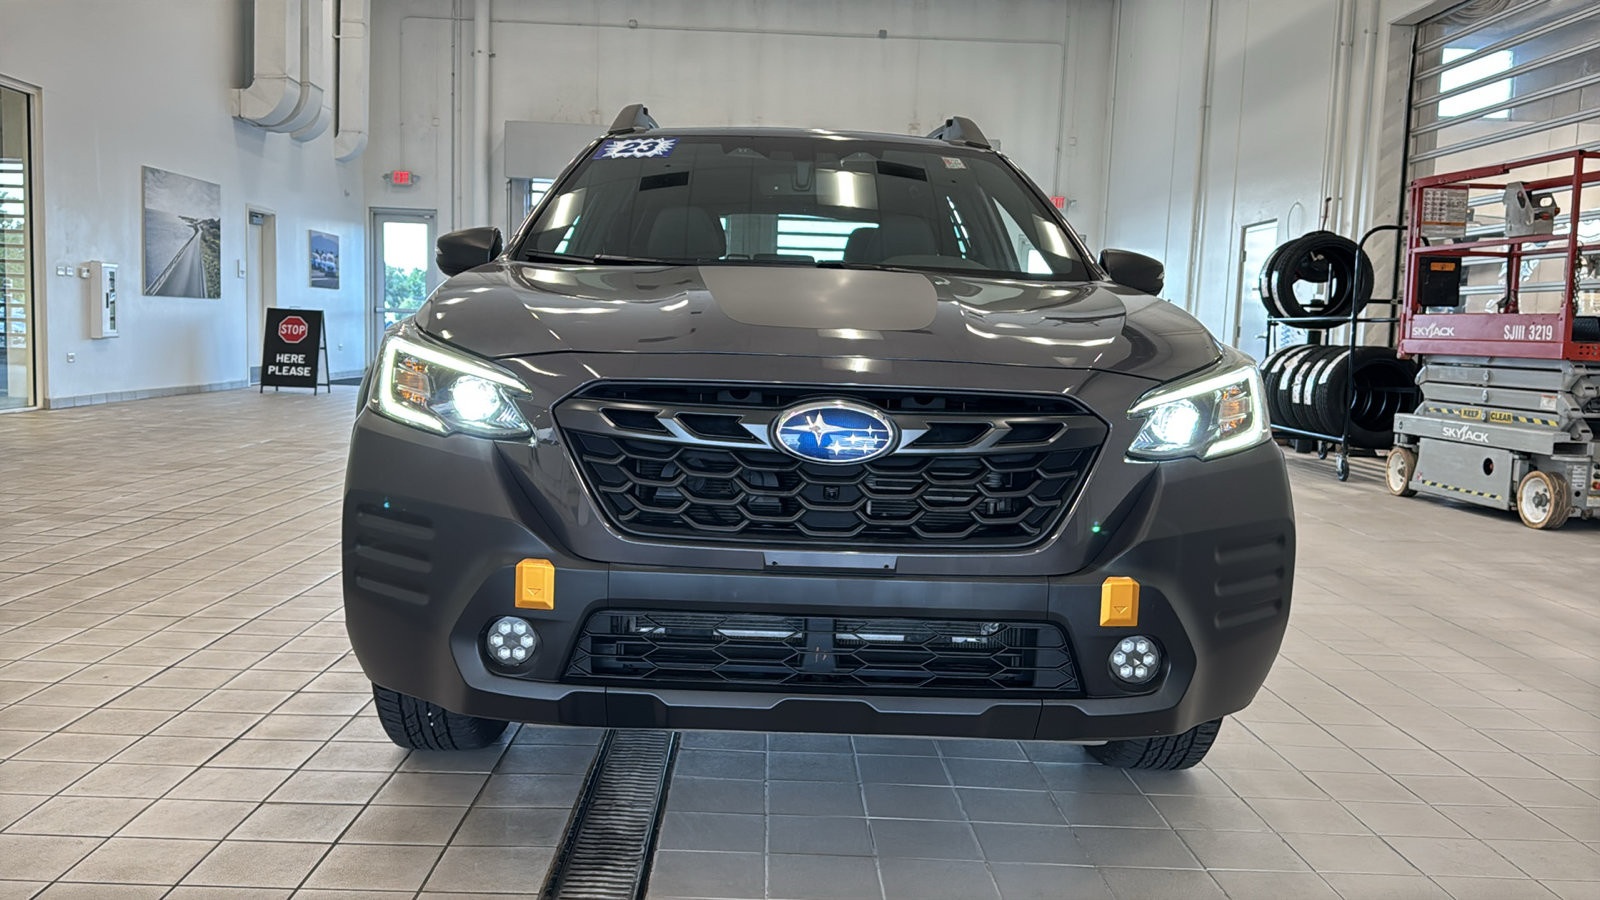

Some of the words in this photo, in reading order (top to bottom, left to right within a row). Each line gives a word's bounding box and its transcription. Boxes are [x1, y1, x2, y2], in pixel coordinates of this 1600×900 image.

[616, 141, 660, 153] 23
[280, 324, 306, 335] STOP
[1412, 322, 1455, 338] SKYJACK
[1503, 324, 1526, 340] SJIII
[1528, 325, 1553, 340] 3219
[276, 353, 306, 364] HERE
[267, 365, 312, 377] PLEASE
[1462, 408, 1480, 417] KEEP
[1490, 411, 1512, 421] CLEAR
[1442, 425, 1489, 443] SKYJACK
